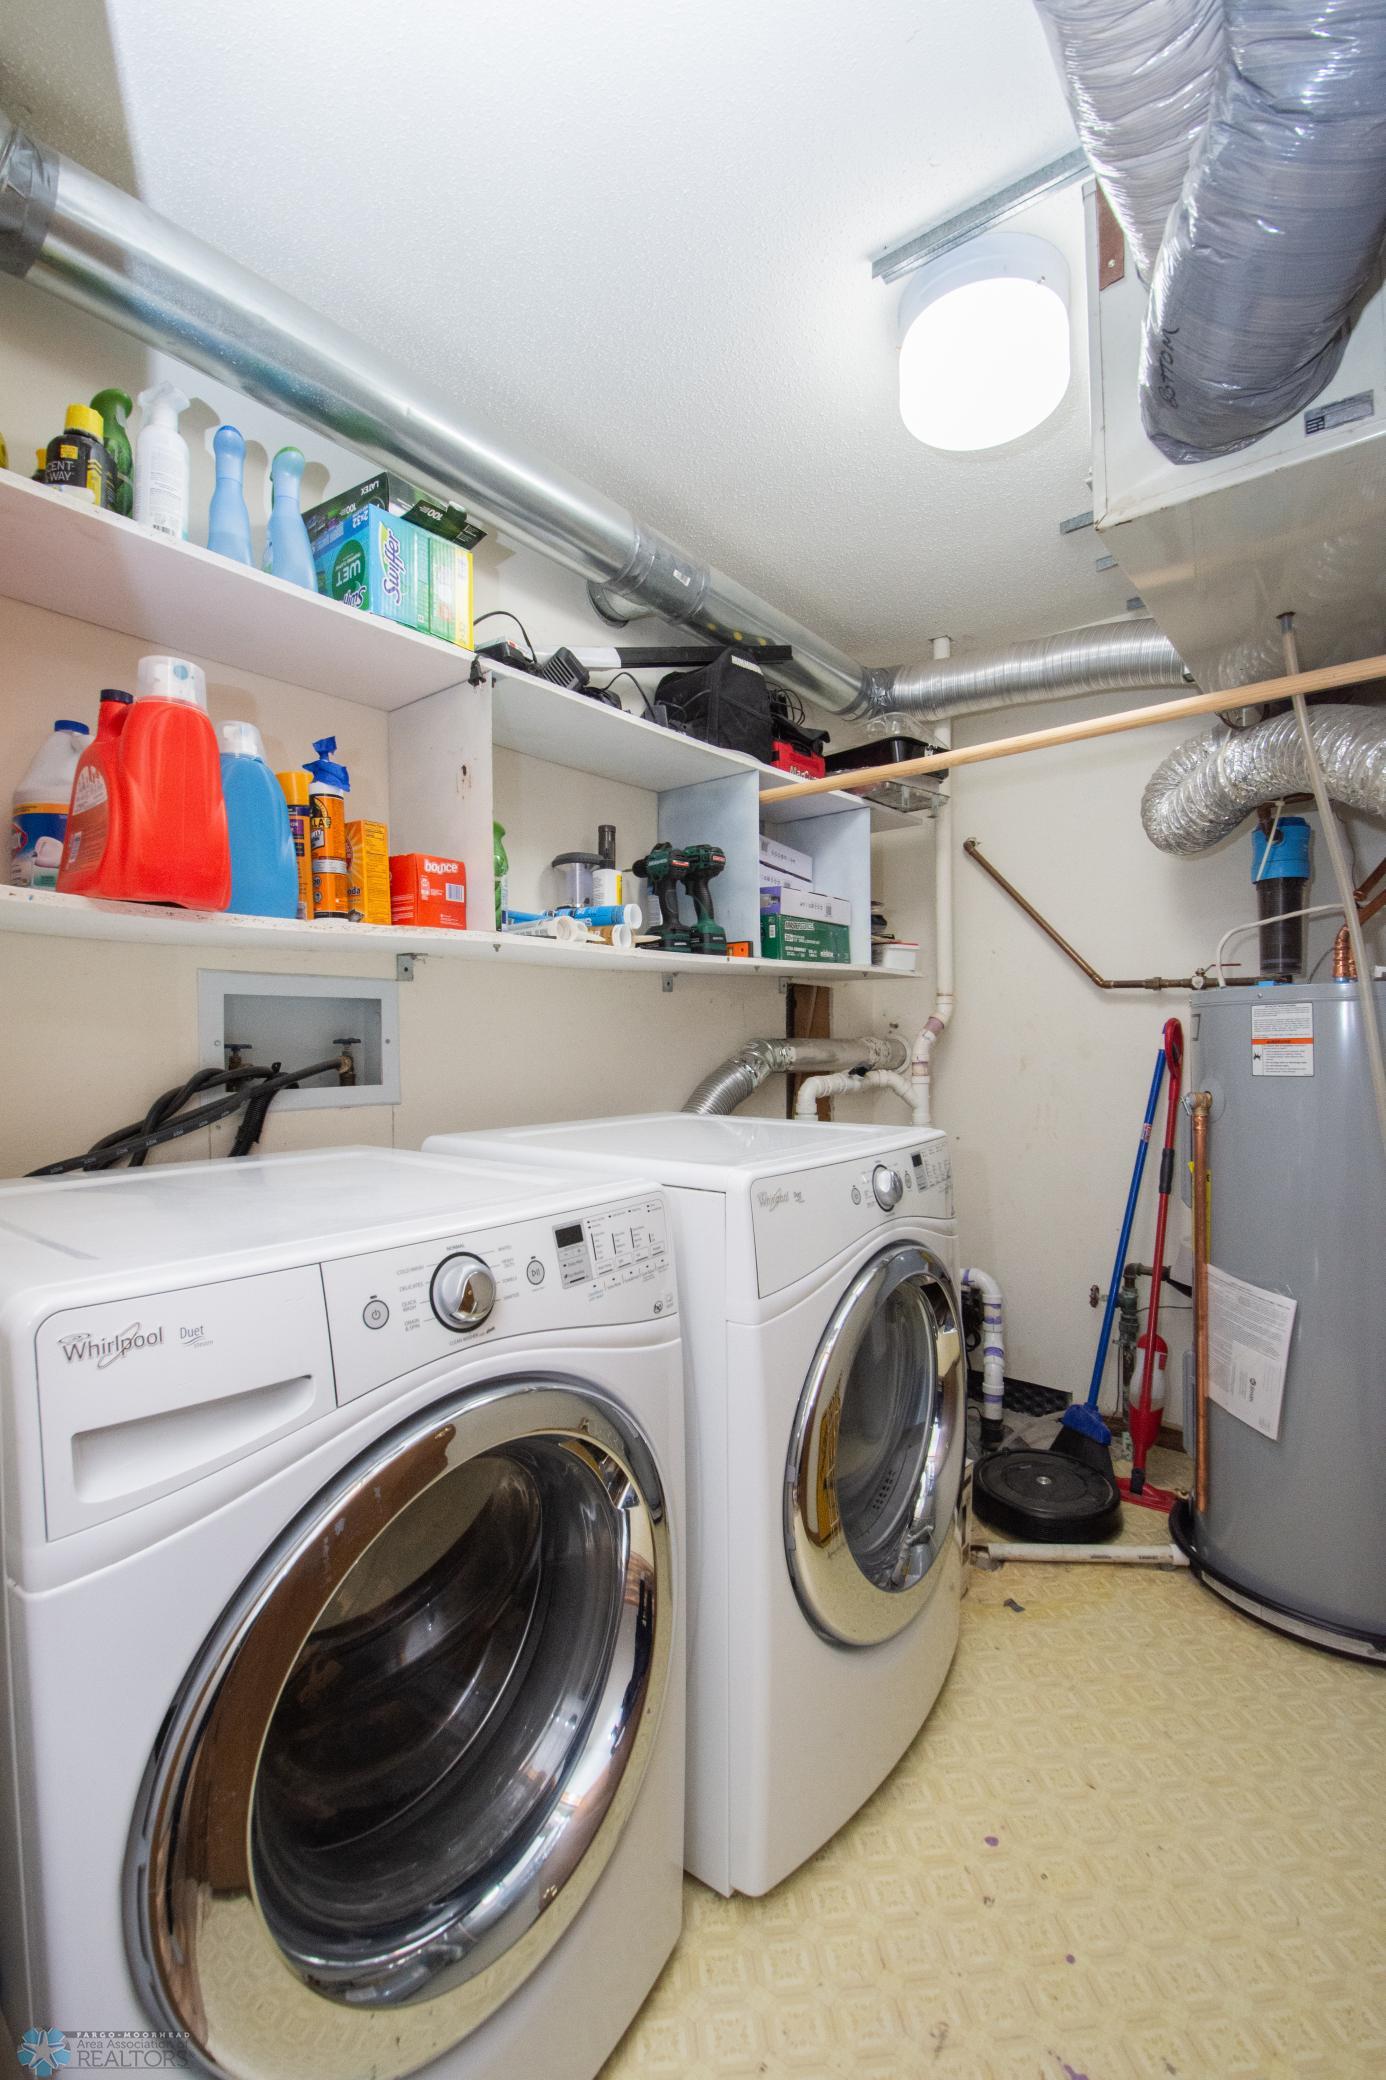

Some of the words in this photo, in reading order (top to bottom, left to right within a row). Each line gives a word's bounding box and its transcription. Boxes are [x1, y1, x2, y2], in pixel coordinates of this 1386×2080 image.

[335, 559, 361, 588] WET
[383, 528, 407, 606] Swiffer
[424, 858, 458, 875] bounce
[62, 1326, 163, 1362] Whirlpool
[179, 1324, 205, 1340] Duet
